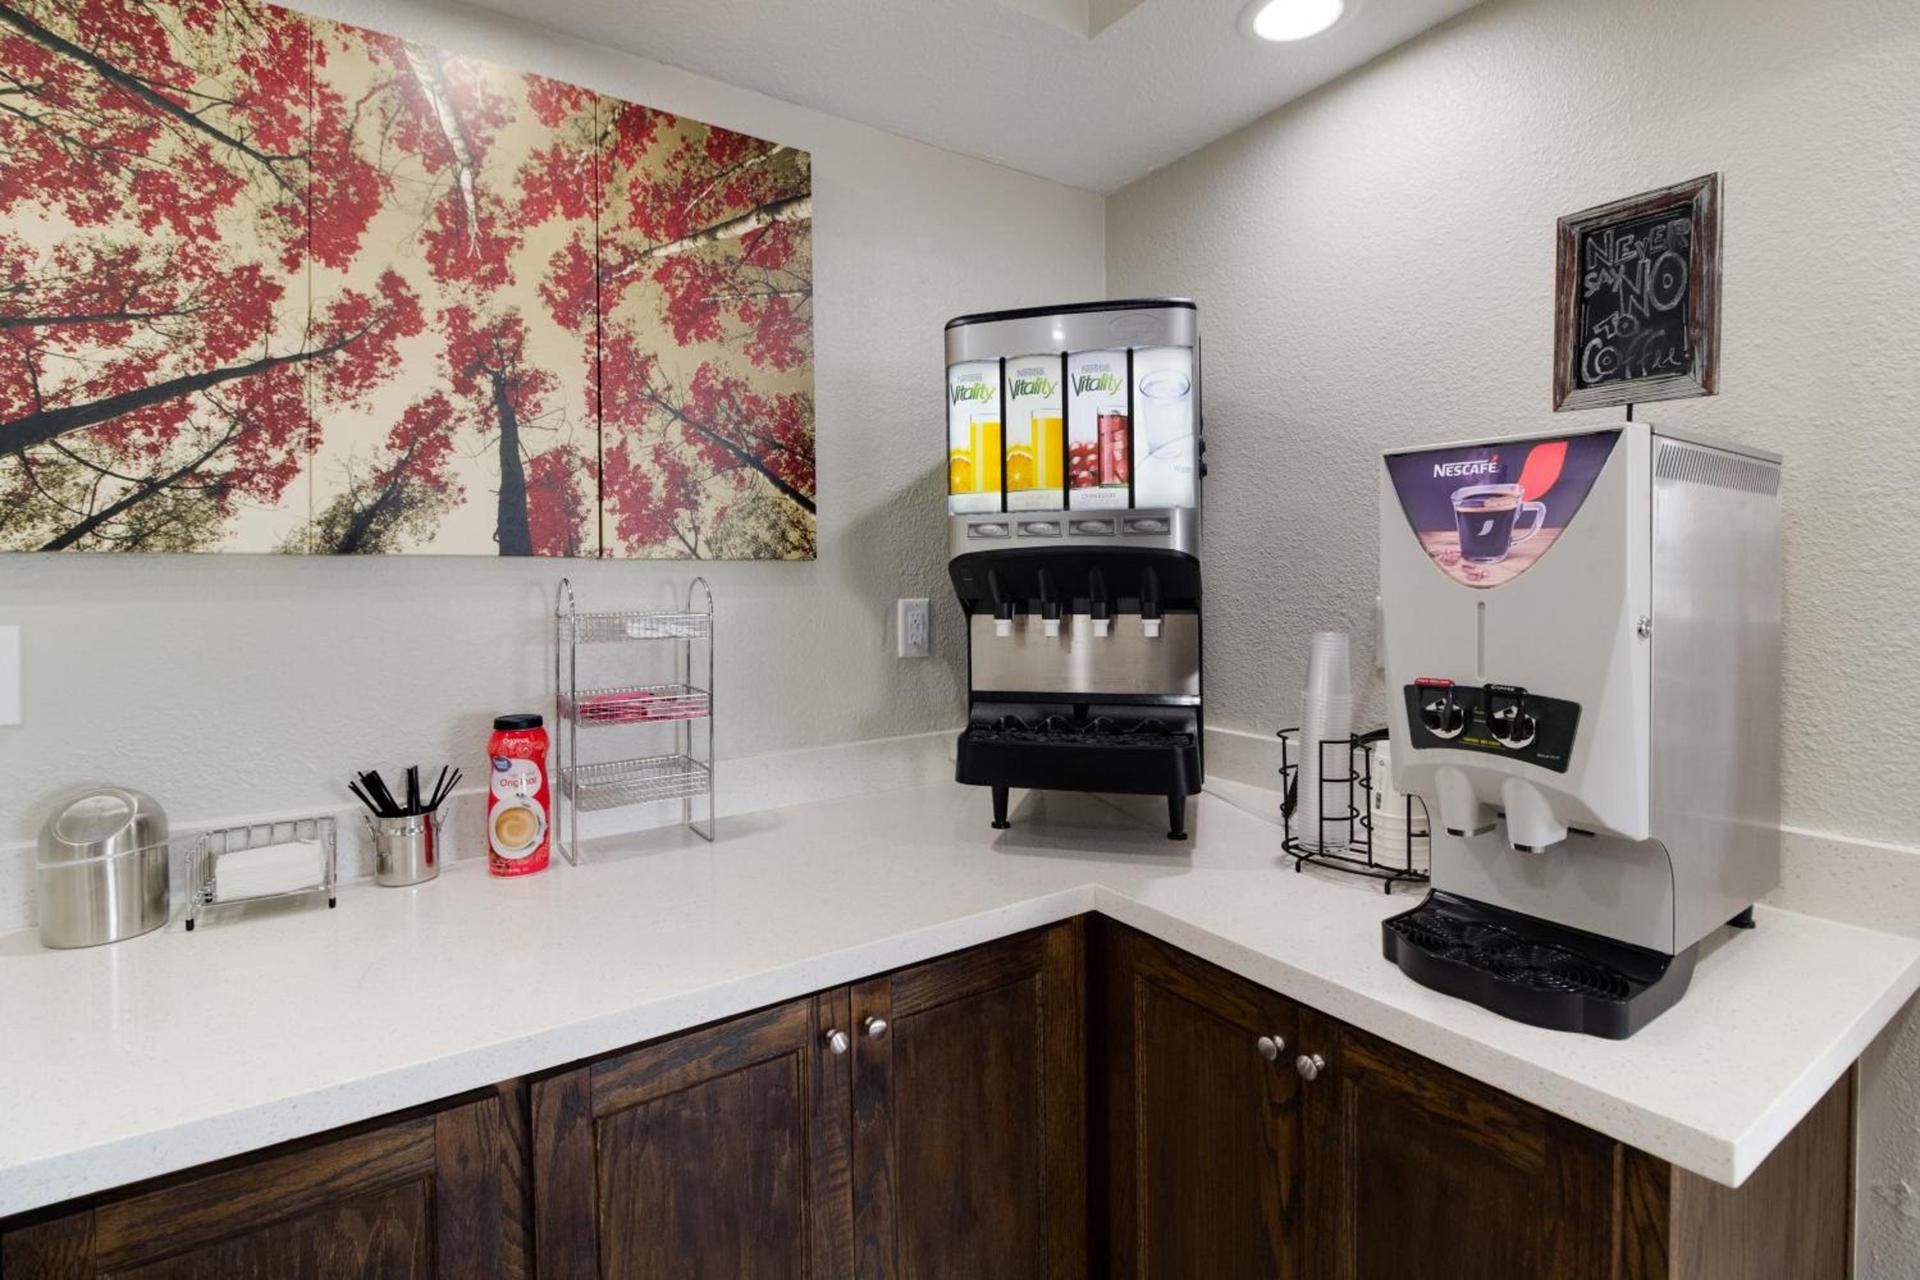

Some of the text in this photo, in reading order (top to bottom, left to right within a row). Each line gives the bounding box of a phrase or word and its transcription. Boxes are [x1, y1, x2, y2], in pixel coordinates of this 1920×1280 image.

[1586, 218, 1692, 269] NEVER
[1583, 250, 1688, 319] SAY NO
[950, 382, 996, 406] Vitality
[1008, 376, 1058, 400] Vitality
[1071, 372, 1123, 397] Vitality
